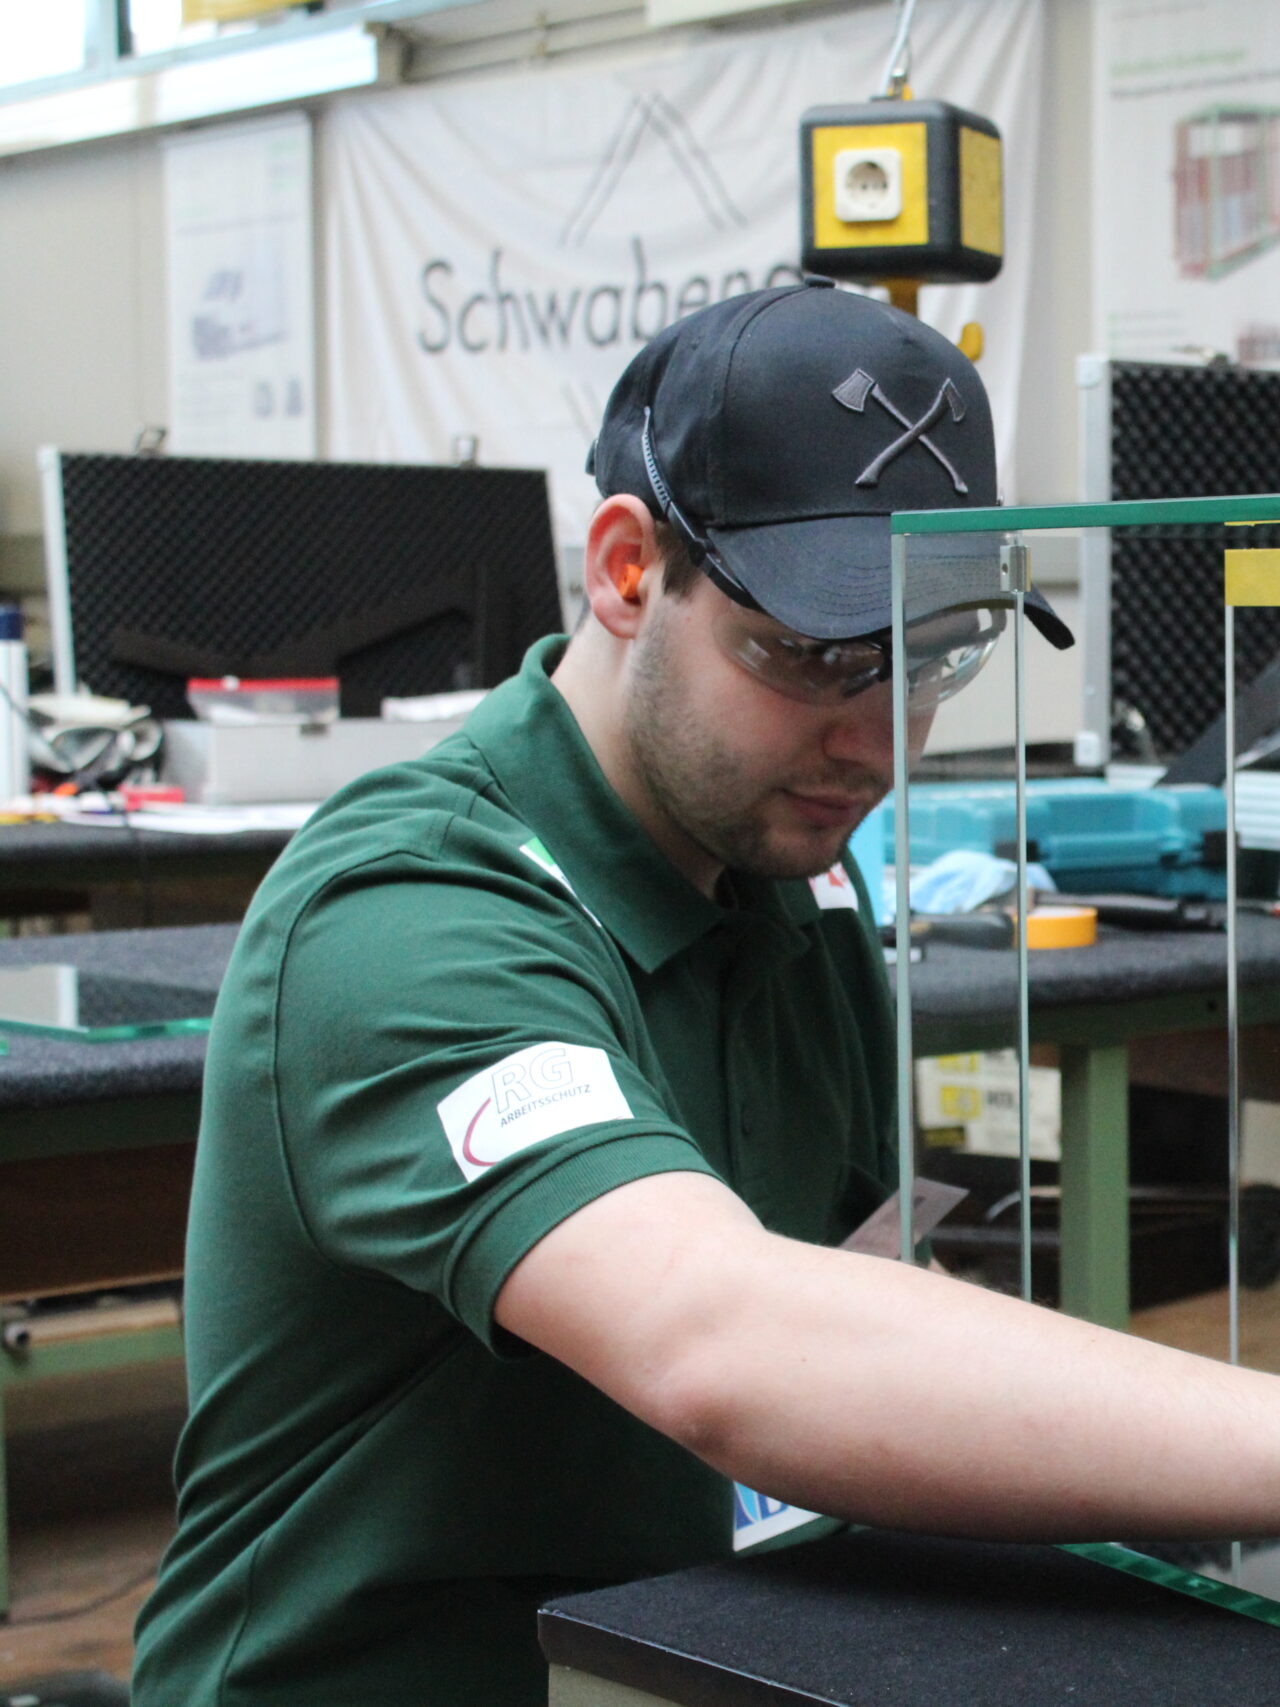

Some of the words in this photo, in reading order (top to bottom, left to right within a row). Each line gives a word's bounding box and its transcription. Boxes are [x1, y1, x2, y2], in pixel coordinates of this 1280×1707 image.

[418, 235, 804, 354] Schwabe
[491, 1047, 574, 1114] RG
[500, 1084, 591, 1128] ARBEITSSCHUTZ
